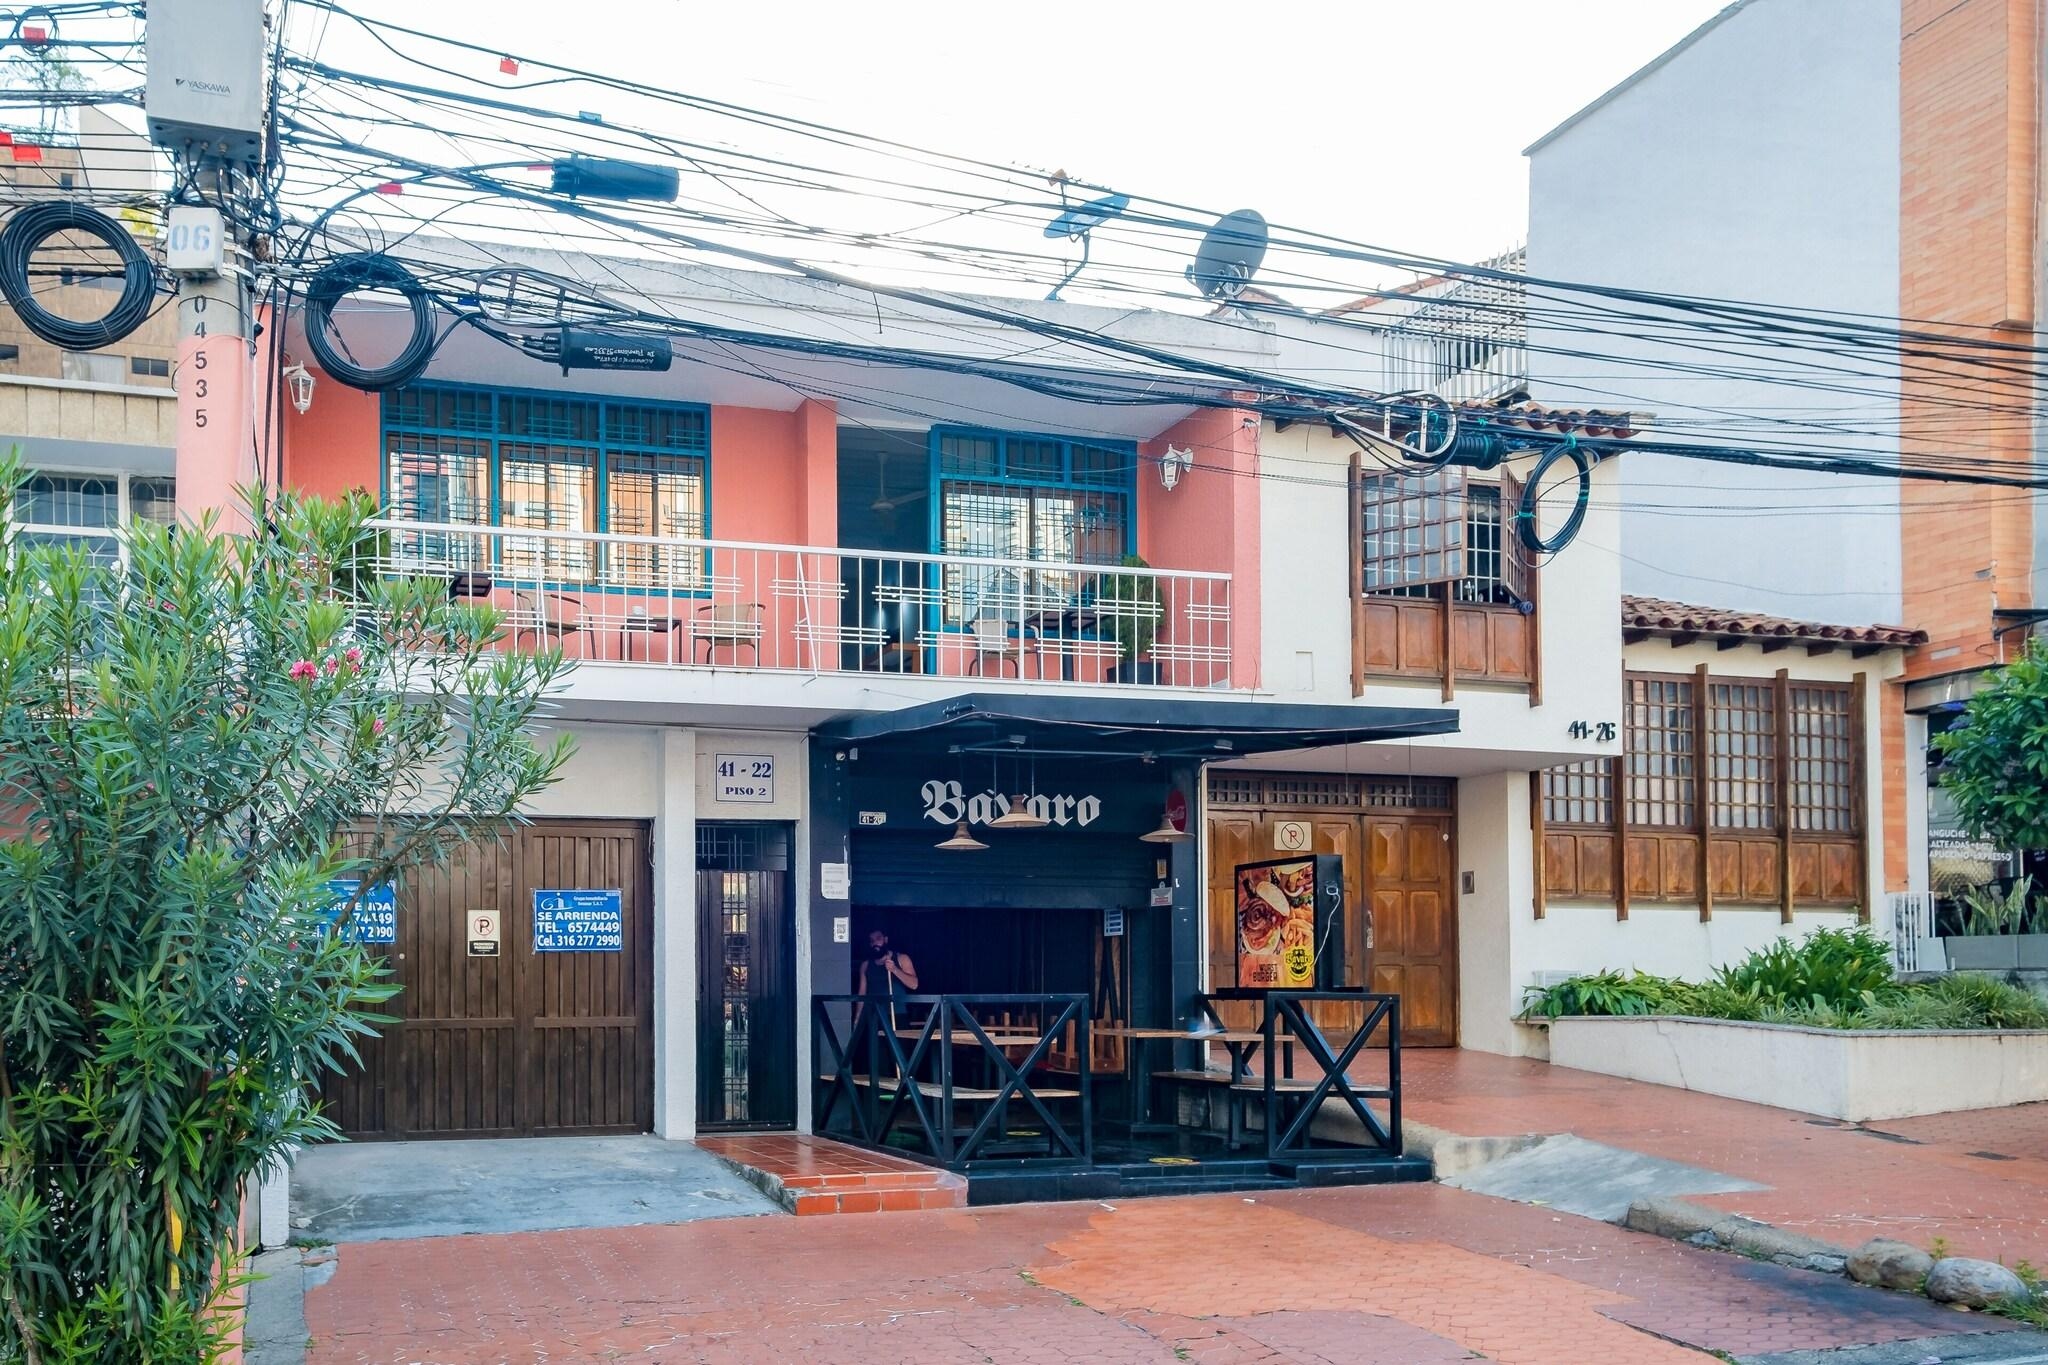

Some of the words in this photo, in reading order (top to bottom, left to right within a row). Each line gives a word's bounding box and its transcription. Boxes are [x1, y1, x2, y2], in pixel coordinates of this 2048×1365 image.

[187, 80, 231, 94] YASKAWA
[172, 224, 210, 250] 06
[718, 761, 735, 777] 41
[752, 762, 772, 778] 22
[725, 786, 754, 796] PISO
[758, 787, 767, 796] 2
[537, 911, 552, 920] SE
[555, 911, 619, 920] ARRIENDA
[537, 921, 562, 933] TEL.
[567, 921, 619, 933] 6574449
[537, 934, 555, 946] Cel.
[557, 934, 575, 946] 316
[576, 934, 594, 946] 277
[596, 934, 620, 946] 2990
